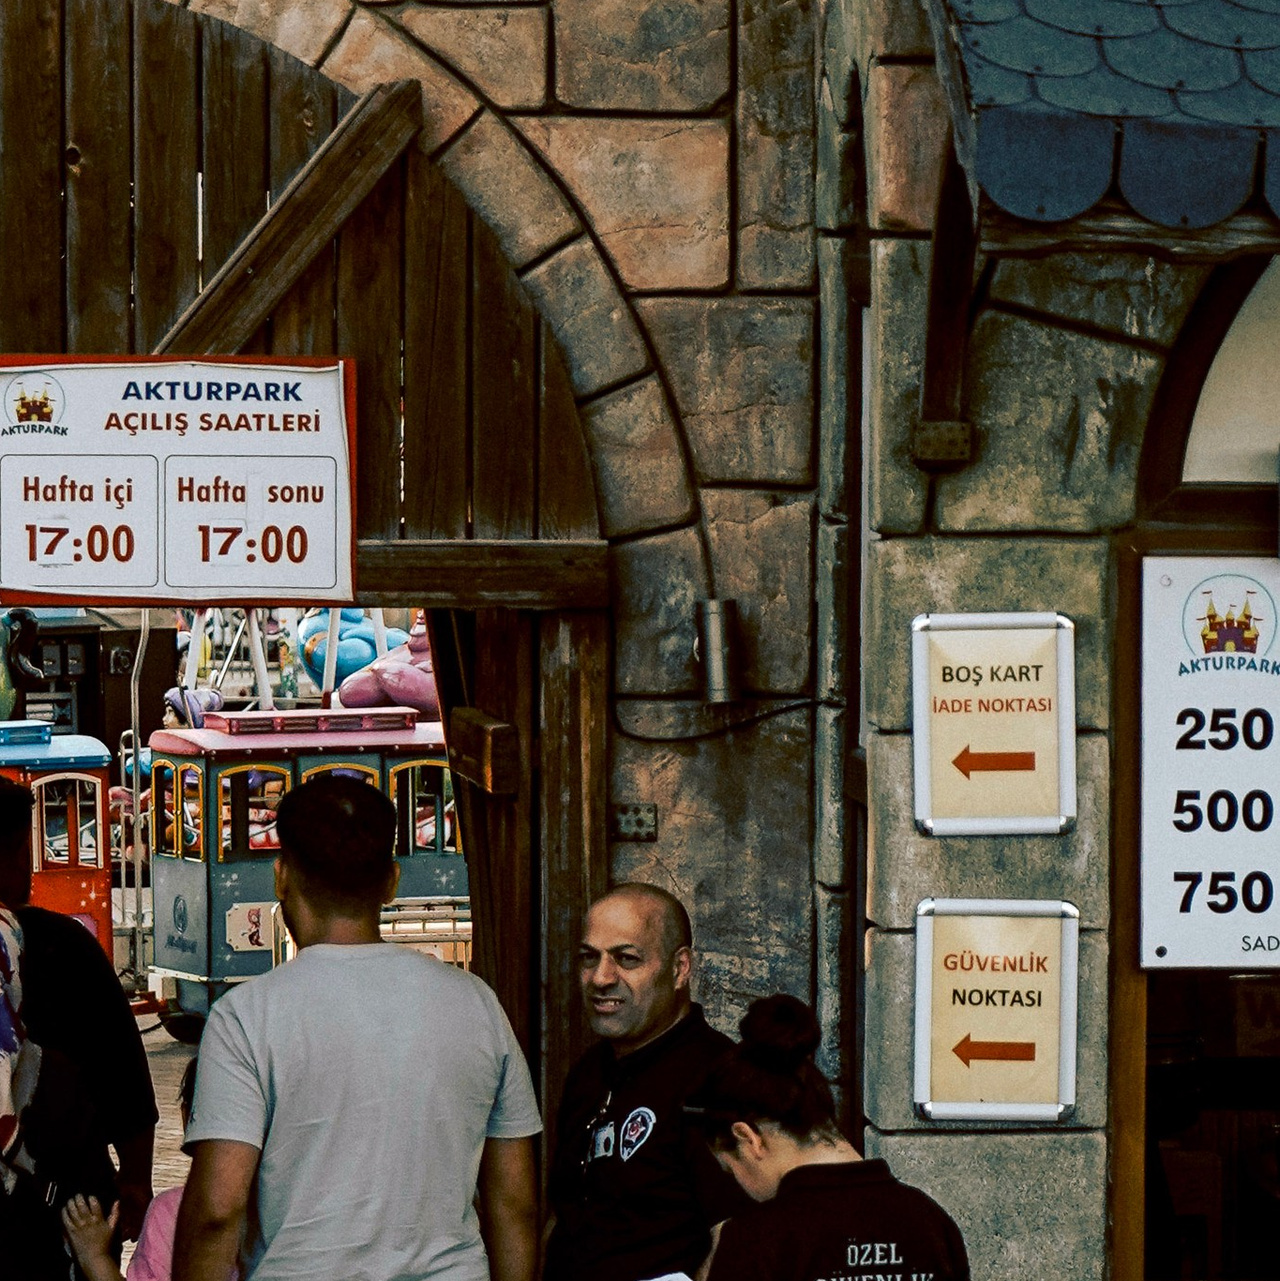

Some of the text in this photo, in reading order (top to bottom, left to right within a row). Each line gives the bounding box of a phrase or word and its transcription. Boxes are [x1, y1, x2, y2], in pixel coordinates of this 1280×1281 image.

[121, 381, 303, 402] AKTURPARK
[0, 424, 69, 437] AKTURPARK
[104, 408, 321, 437] AÇILIŞ SAATLERİ
[23, 474, 134, 510] Hafta içi
[177, 475, 325, 504] Hafta sonu
[24, 523, 136, 563] 17:00
[197, 523, 310, 564] 17:00
[941, 664, 1044, 687] BOŞ KART
[932, 696, 1053, 714] İADE NOKTASI
[1175, 707, 1274, 751] 250
[1172, 789, 1274, 833] 500
[1173, 870, 1274, 914] 750
[943, 950, 1048, 973] GÜVENLİK
[952, 988, 1042, 1007] NOKTASI
[847, 1237, 904, 1266] ÖZEL
